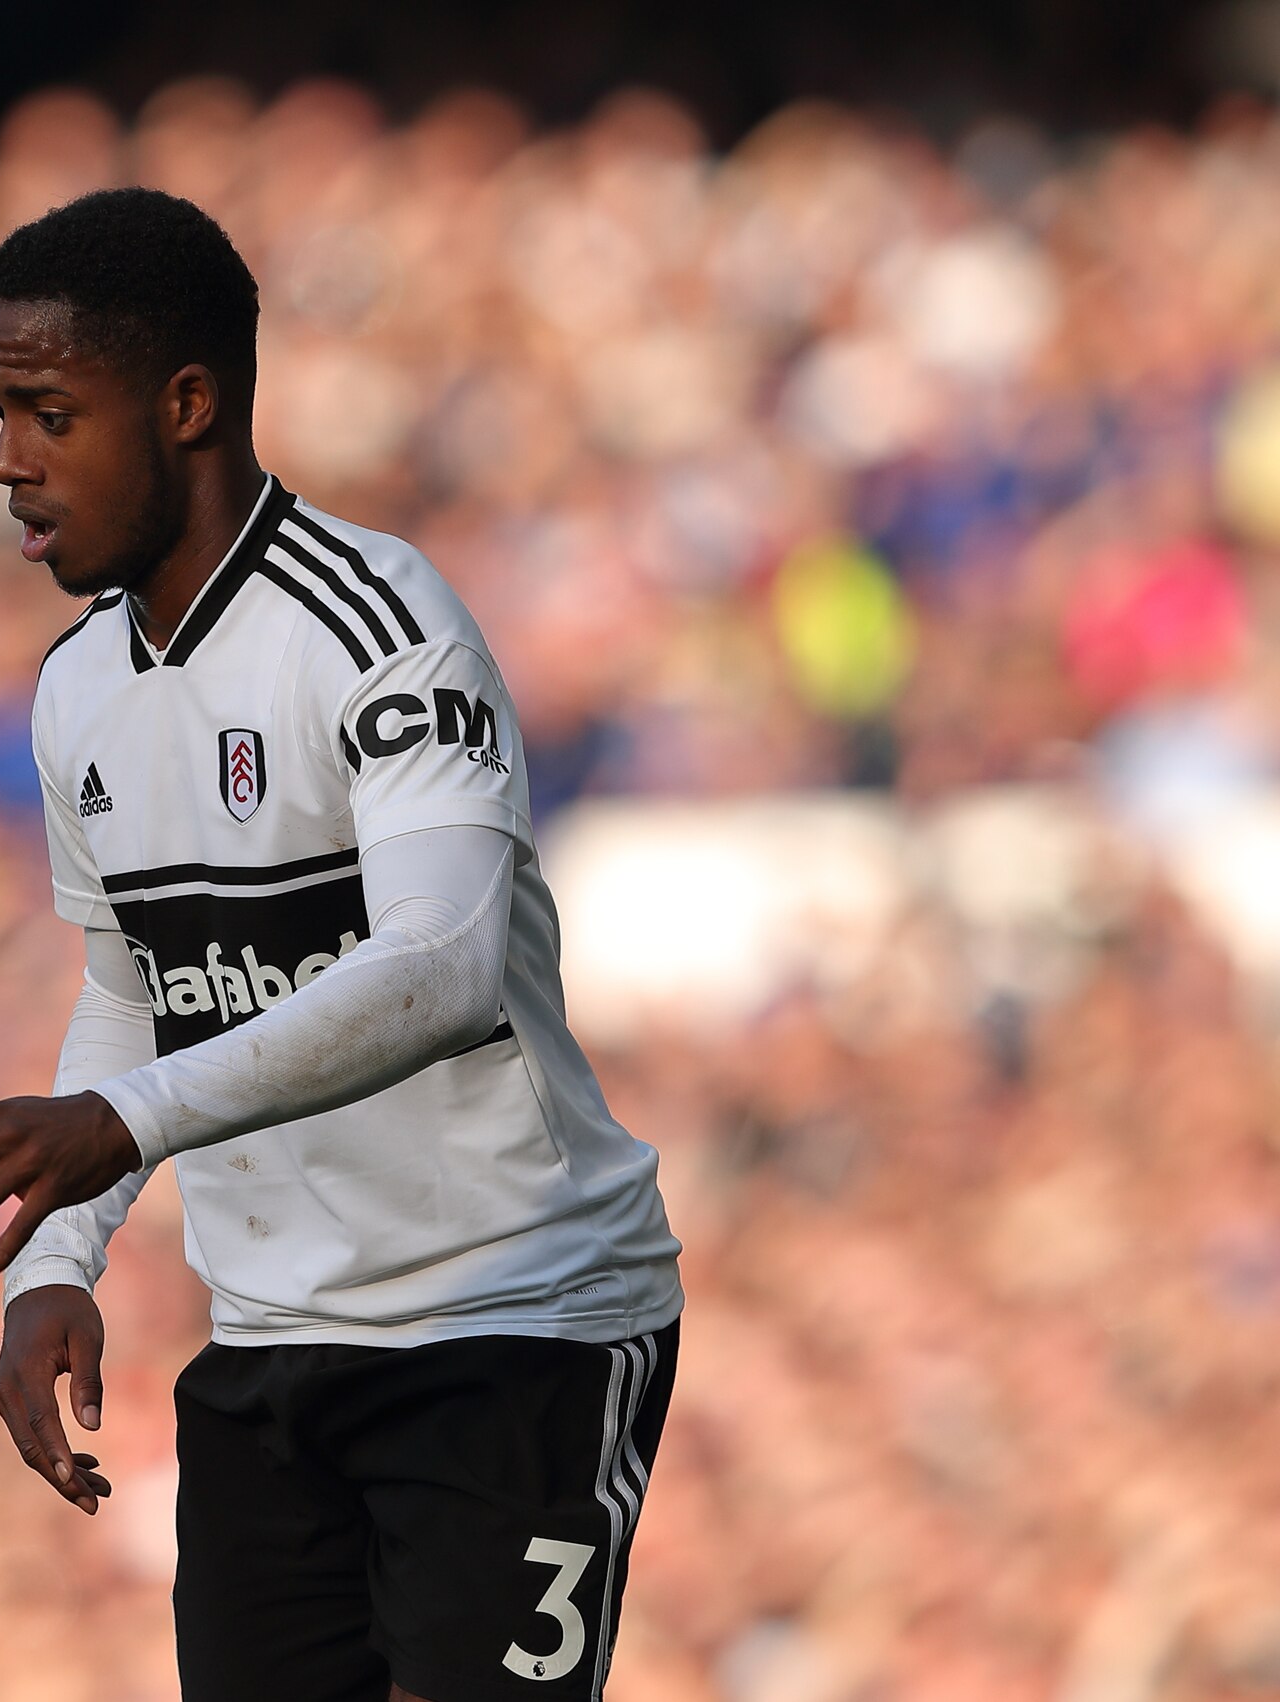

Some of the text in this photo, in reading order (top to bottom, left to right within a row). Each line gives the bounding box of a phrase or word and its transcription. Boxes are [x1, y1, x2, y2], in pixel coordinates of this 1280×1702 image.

[230, 740, 254, 803] FFC
[80, 795, 113, 818] adidas
[502, 1537, 596, 1681] 3
